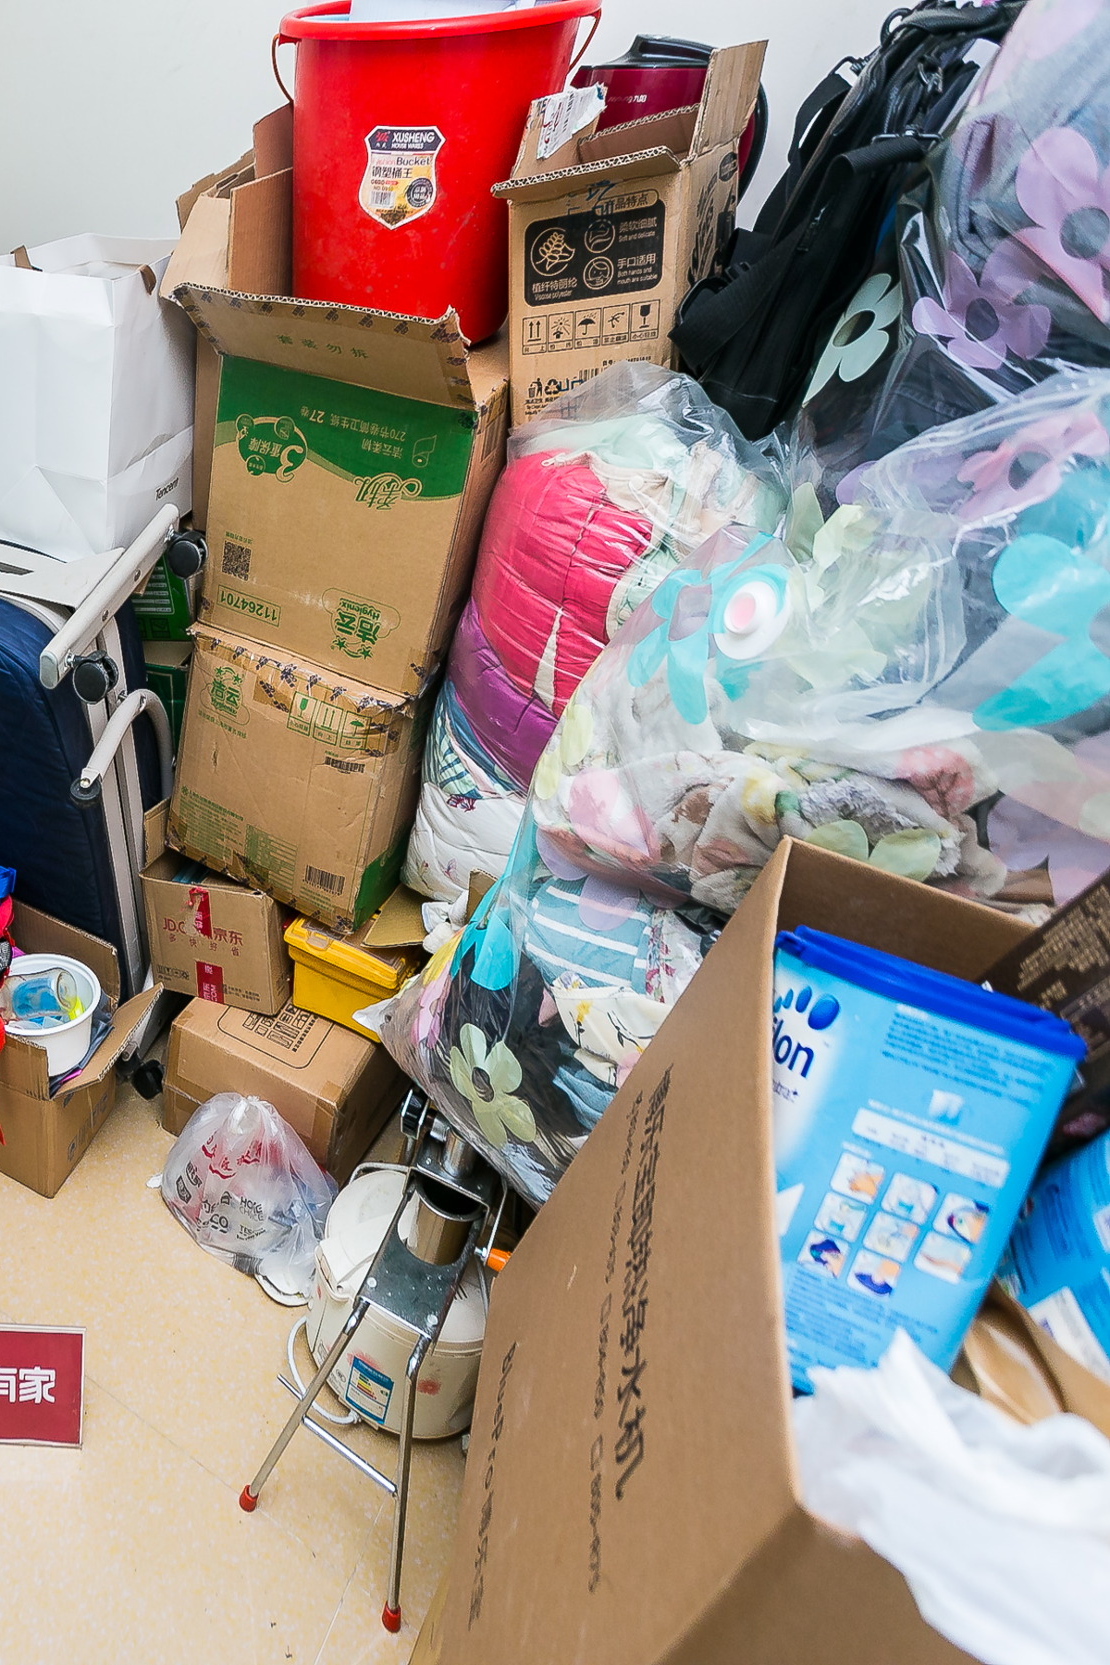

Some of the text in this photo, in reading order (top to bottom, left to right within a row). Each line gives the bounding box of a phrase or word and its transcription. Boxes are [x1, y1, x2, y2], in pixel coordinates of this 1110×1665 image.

[392, 131, 435, 143] XUSHENG
[396, 156, 431, 166] Bucket
[617, 252, 657, 270] 手口适用
[330, 411, 407, 442] 270节卷筒卫生纸
[360, 436, 405, 460] 洁云柔韧
[219, 588, 279, 621] 11264701
[341, 600, 381, 621] Hygienix
[335, 609, 382, 645] 洁云
[210, 678, 241, 709] 洁云
[212, 926, 244, 947] 京东
[484, 1340, 519, 1491] BluePro
